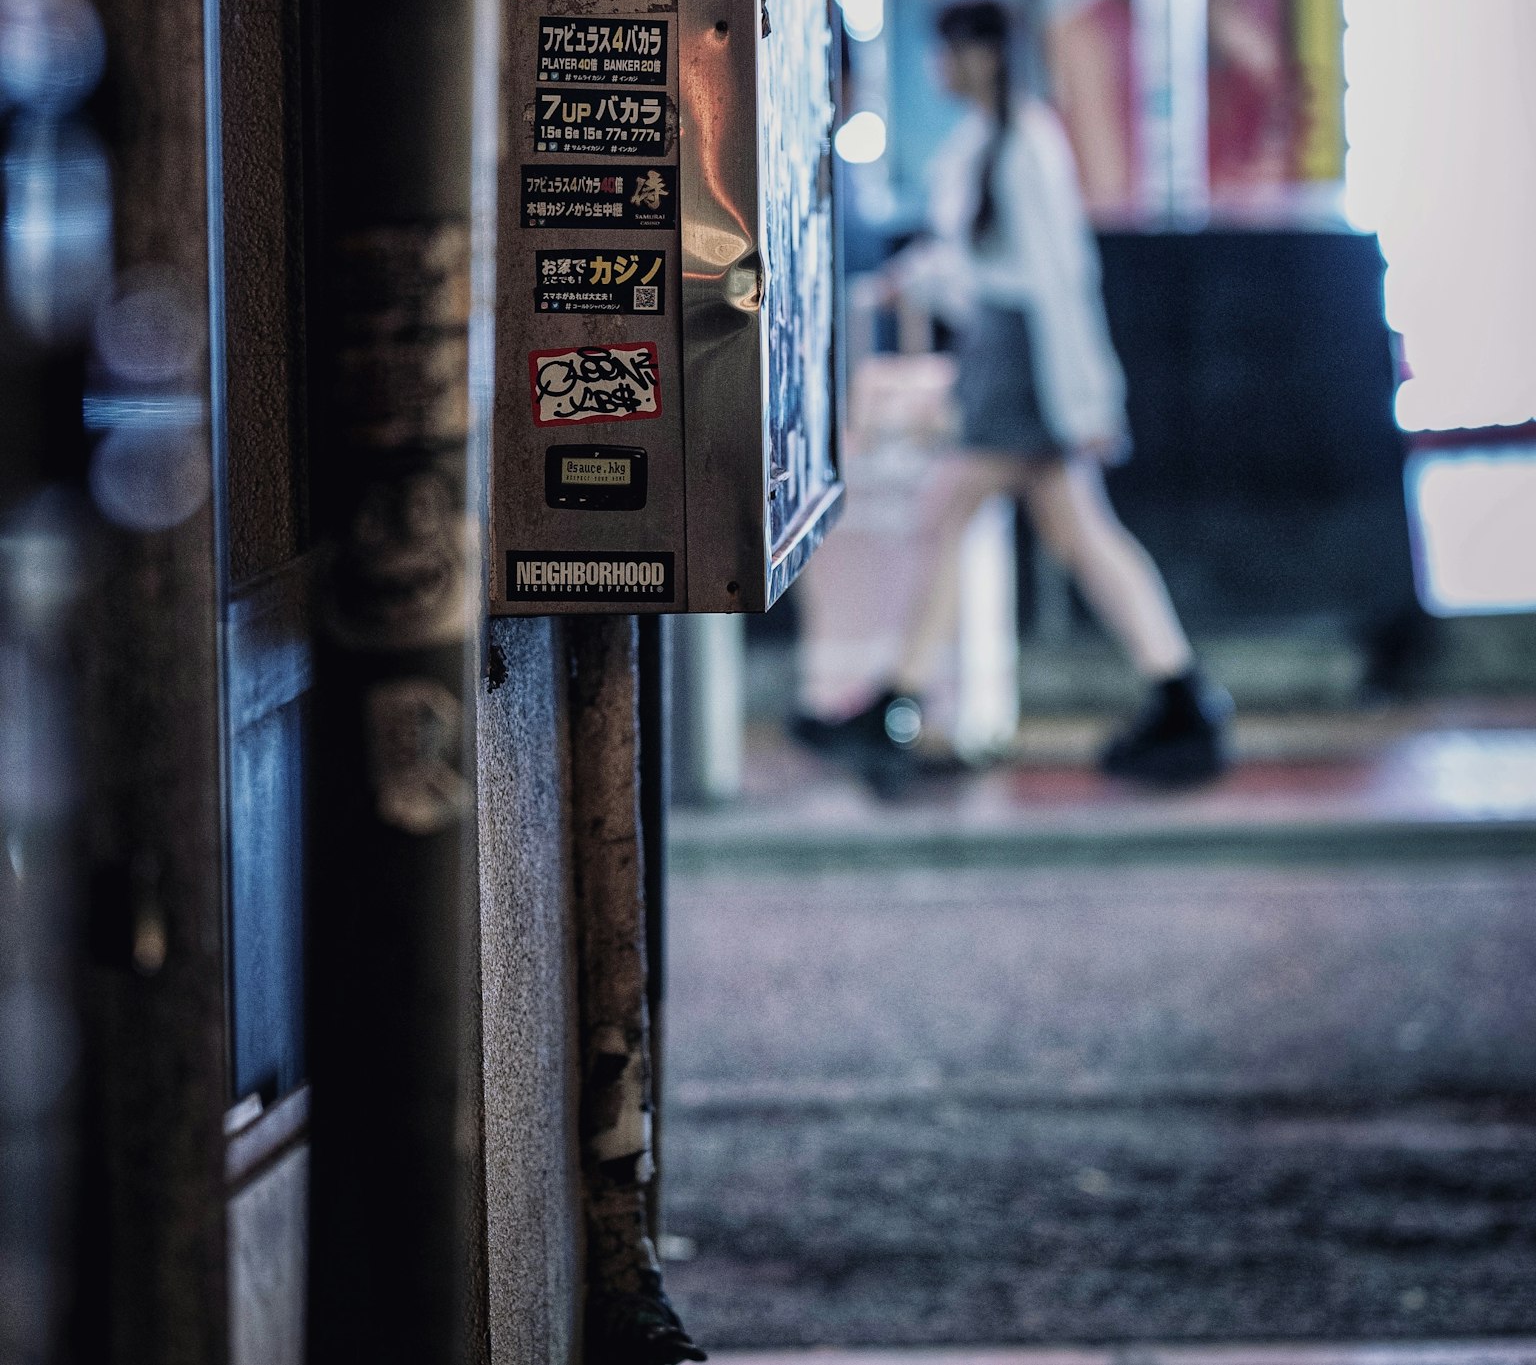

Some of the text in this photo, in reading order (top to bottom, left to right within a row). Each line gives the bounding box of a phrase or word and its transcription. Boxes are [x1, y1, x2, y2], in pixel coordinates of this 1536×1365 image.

[630, 169, 669, 209] 侍
[526, 202, 623, 217] 本場カジノから生中継
[589, 254, 662, 285] カジノ
[566, 461, 626, 474] @sauce.hkg
[516, 561, 665, 585] NEIGHBORHOOD
